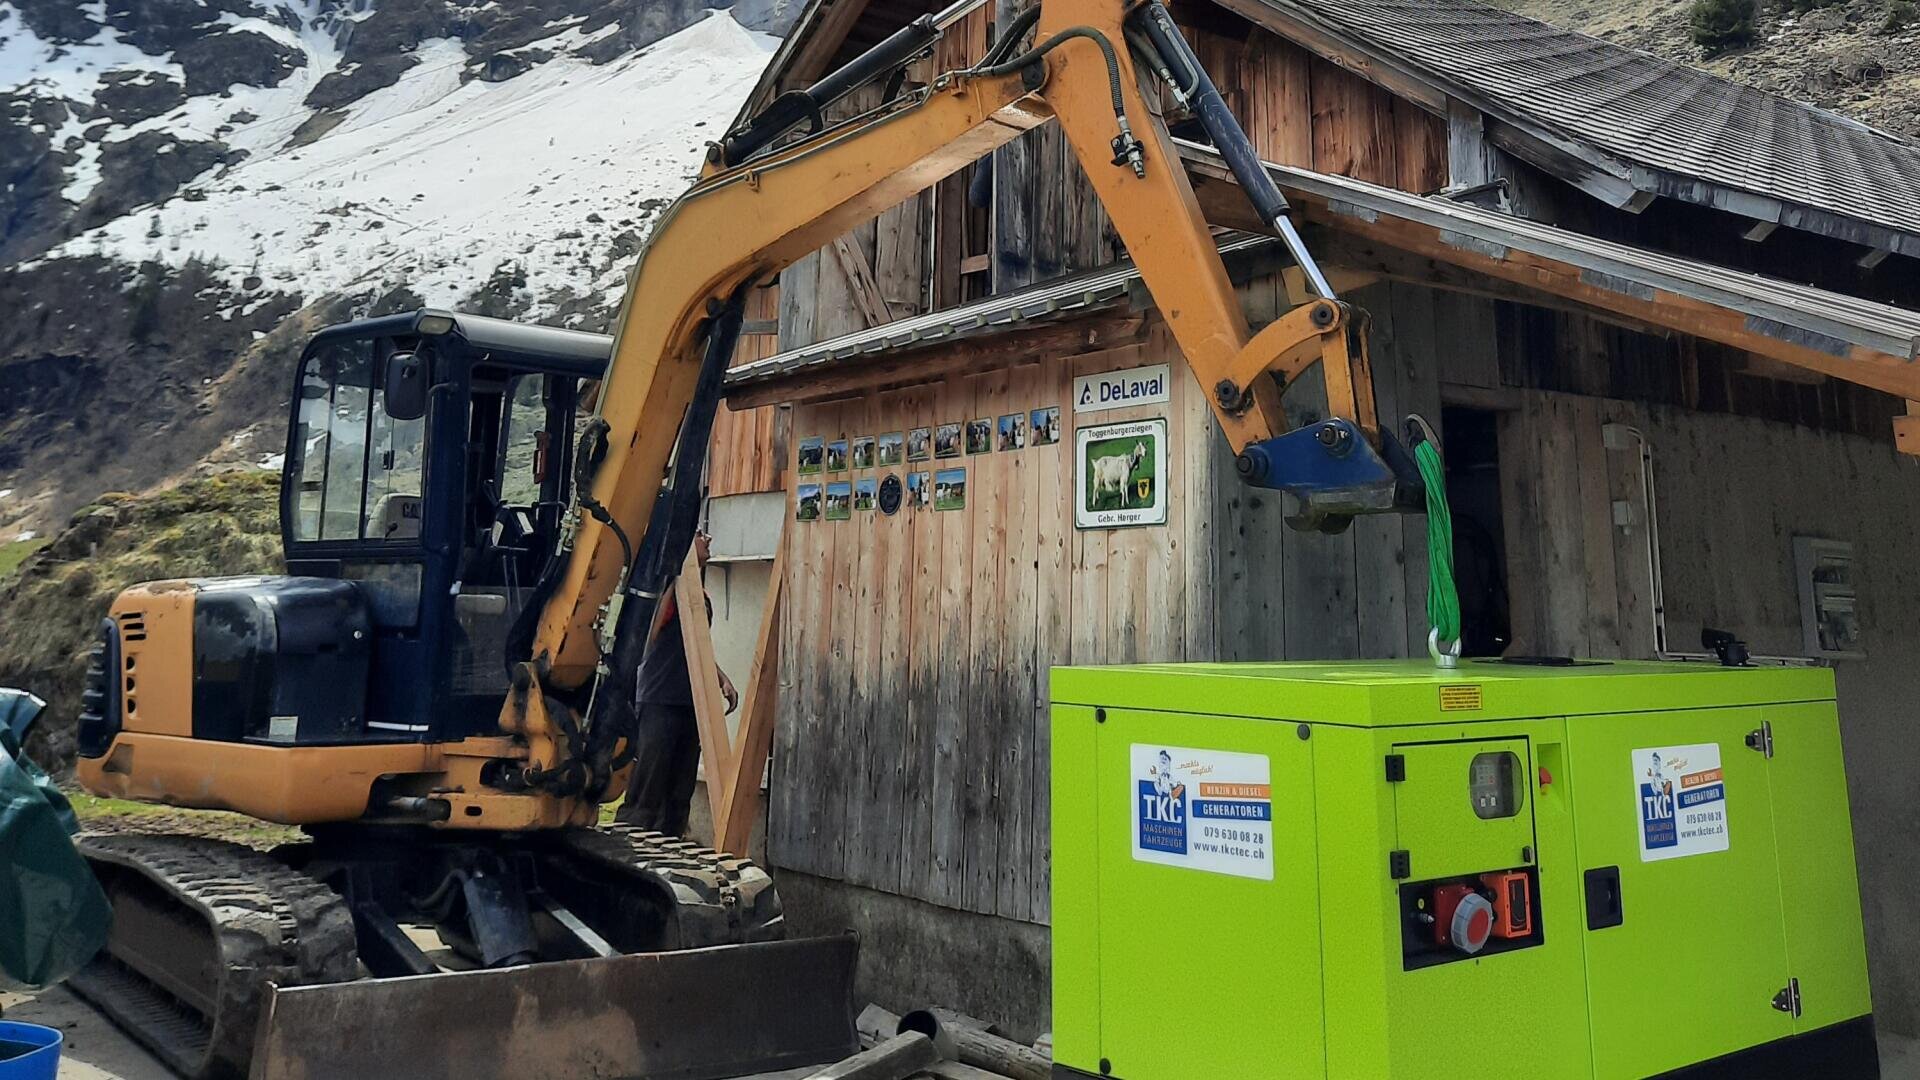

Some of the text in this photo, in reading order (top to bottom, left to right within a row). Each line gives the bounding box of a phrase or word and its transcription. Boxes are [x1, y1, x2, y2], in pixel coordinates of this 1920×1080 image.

[1100, 373, 1163, 402] DeLaval
[1088, 424, 1153, 438] Toggenburgerziegen
[1098, 513, 1141, 523] Gebr. Herger
[1143, 794, 1183, 824] TKC
[1203, 803, 1264, 818] GENERATOREN
[1644, 795, 1673, 821] TKC
[1204, 826, 1264, 845] 079 630 08 28
[1193, 841, 1265, 860] www.tkctec.ch
